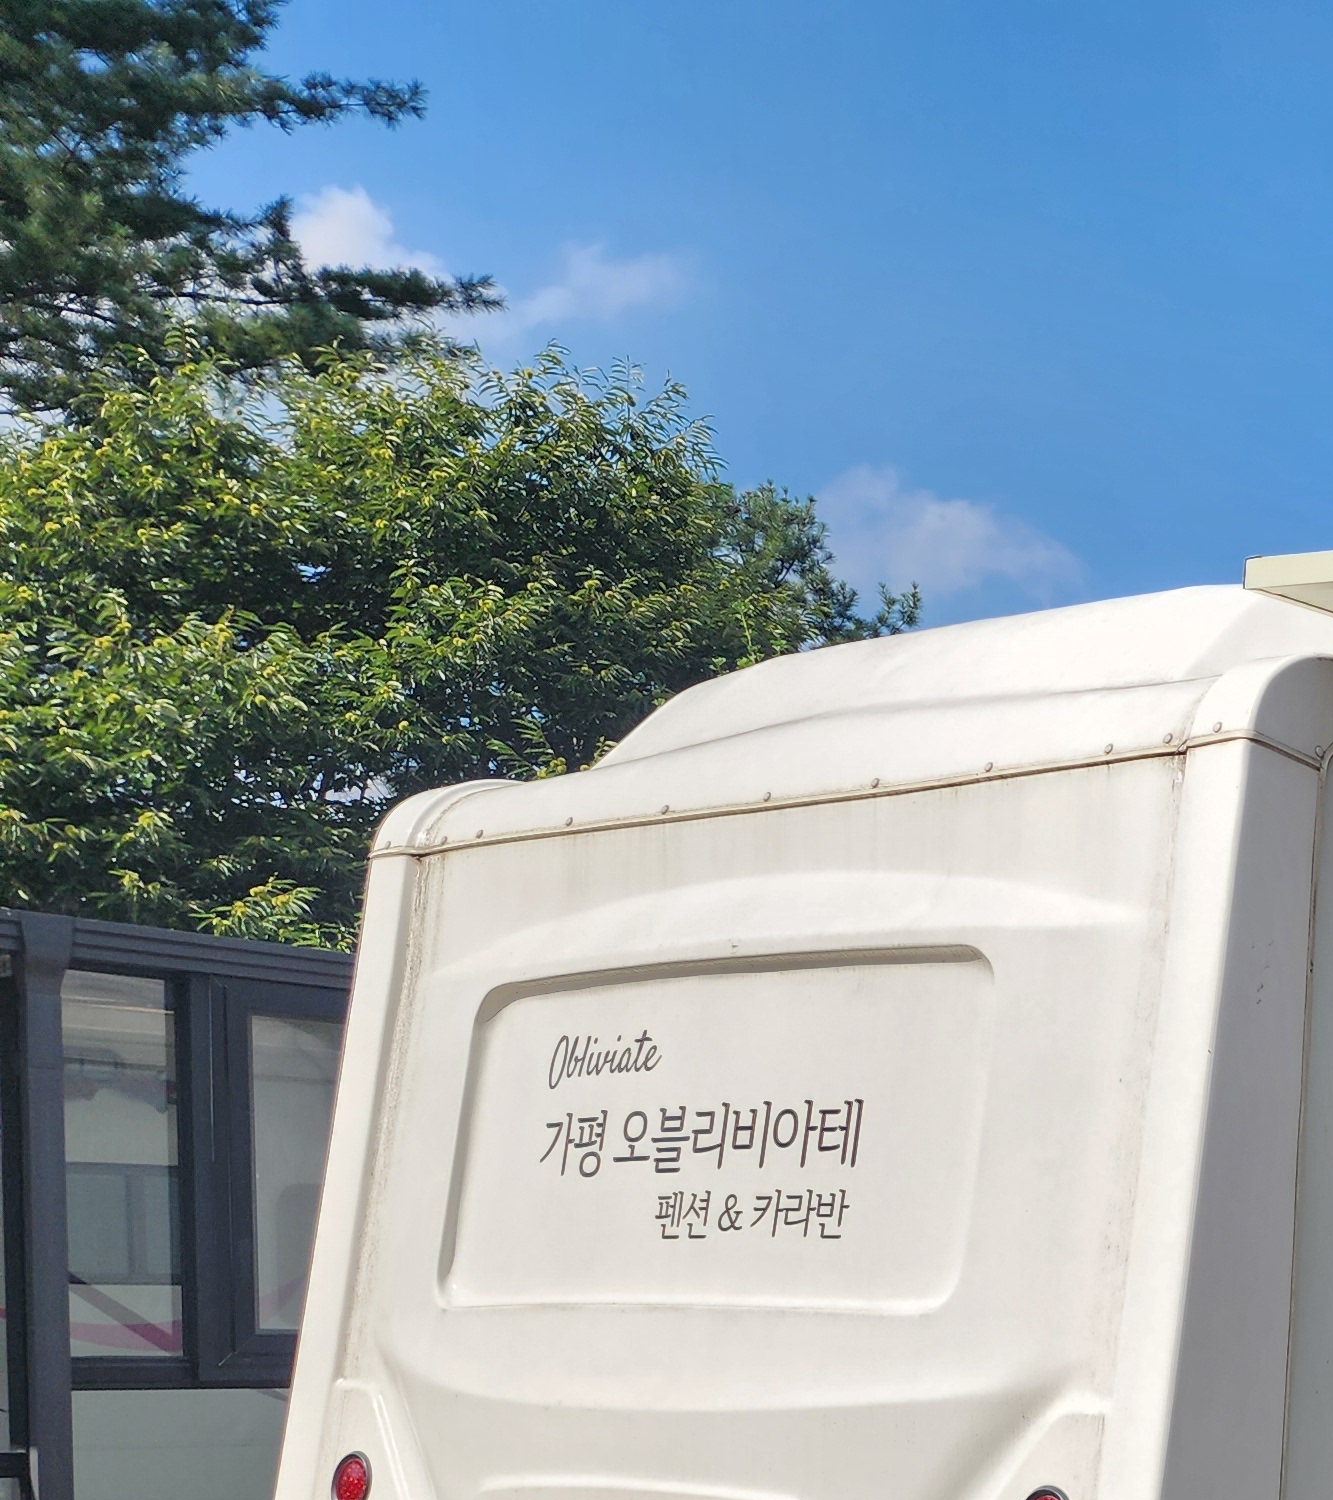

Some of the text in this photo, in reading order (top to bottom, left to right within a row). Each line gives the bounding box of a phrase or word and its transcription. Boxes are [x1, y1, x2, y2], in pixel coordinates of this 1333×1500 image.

[548, 1029, 662, 1090] Obliviate
[539, 1098, 865, 1178] 가평 오블리비아테
[654, 1188, 851, 1240] 펜션 & 카라반
